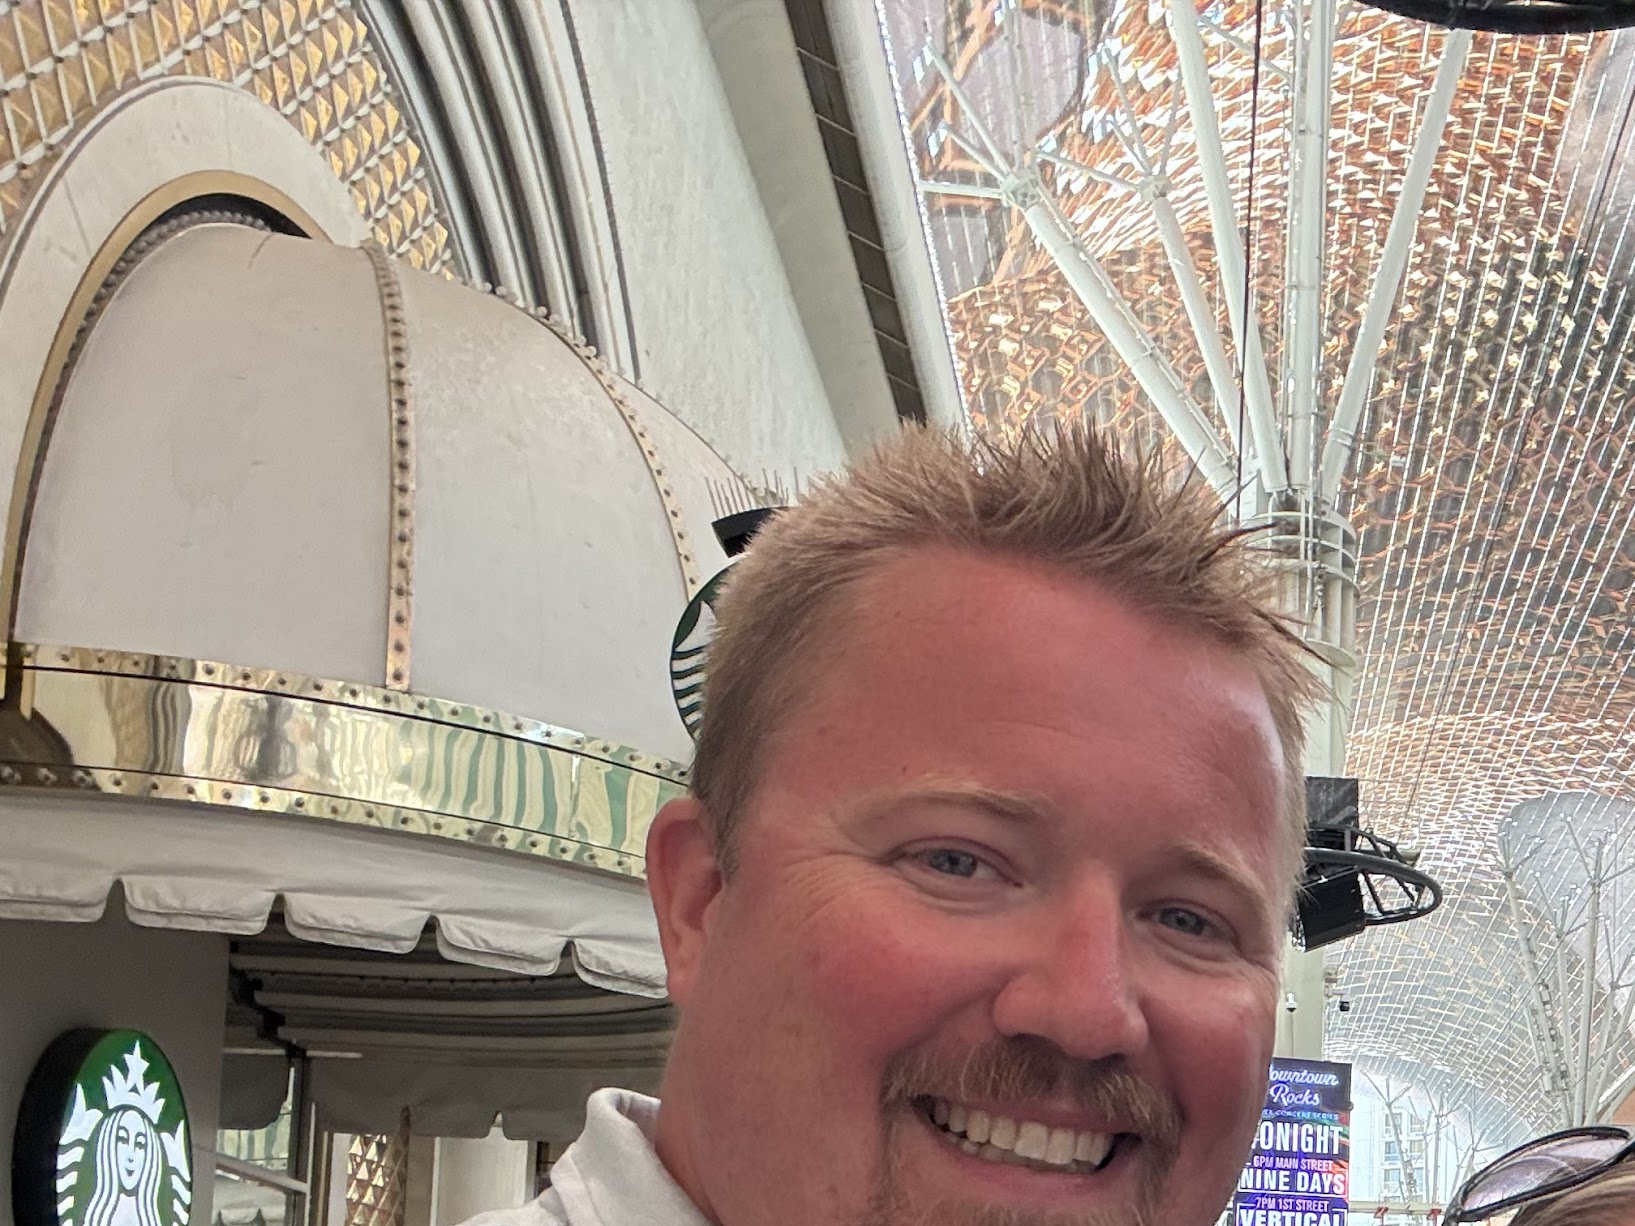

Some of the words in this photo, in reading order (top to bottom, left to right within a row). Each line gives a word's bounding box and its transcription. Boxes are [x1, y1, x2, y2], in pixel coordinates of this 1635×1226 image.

[1269, 1083, 1321, 1106] Rocks
[1253, 1155, 1274, 1168] 6PM
[1275, 1157, 1299, 1170] MAIN
[1300, 1158, 1334, 1171] STREET
[1240, 1168, 1290, 1190] NINE
[1296, 1171, 1345, 1195] DAYS
[1256, 1197, 1275, 1210] 7PM
[1278, 1198, 1294, 1211] 1ST
[1296, 1200, 1329, 1212] STREET
